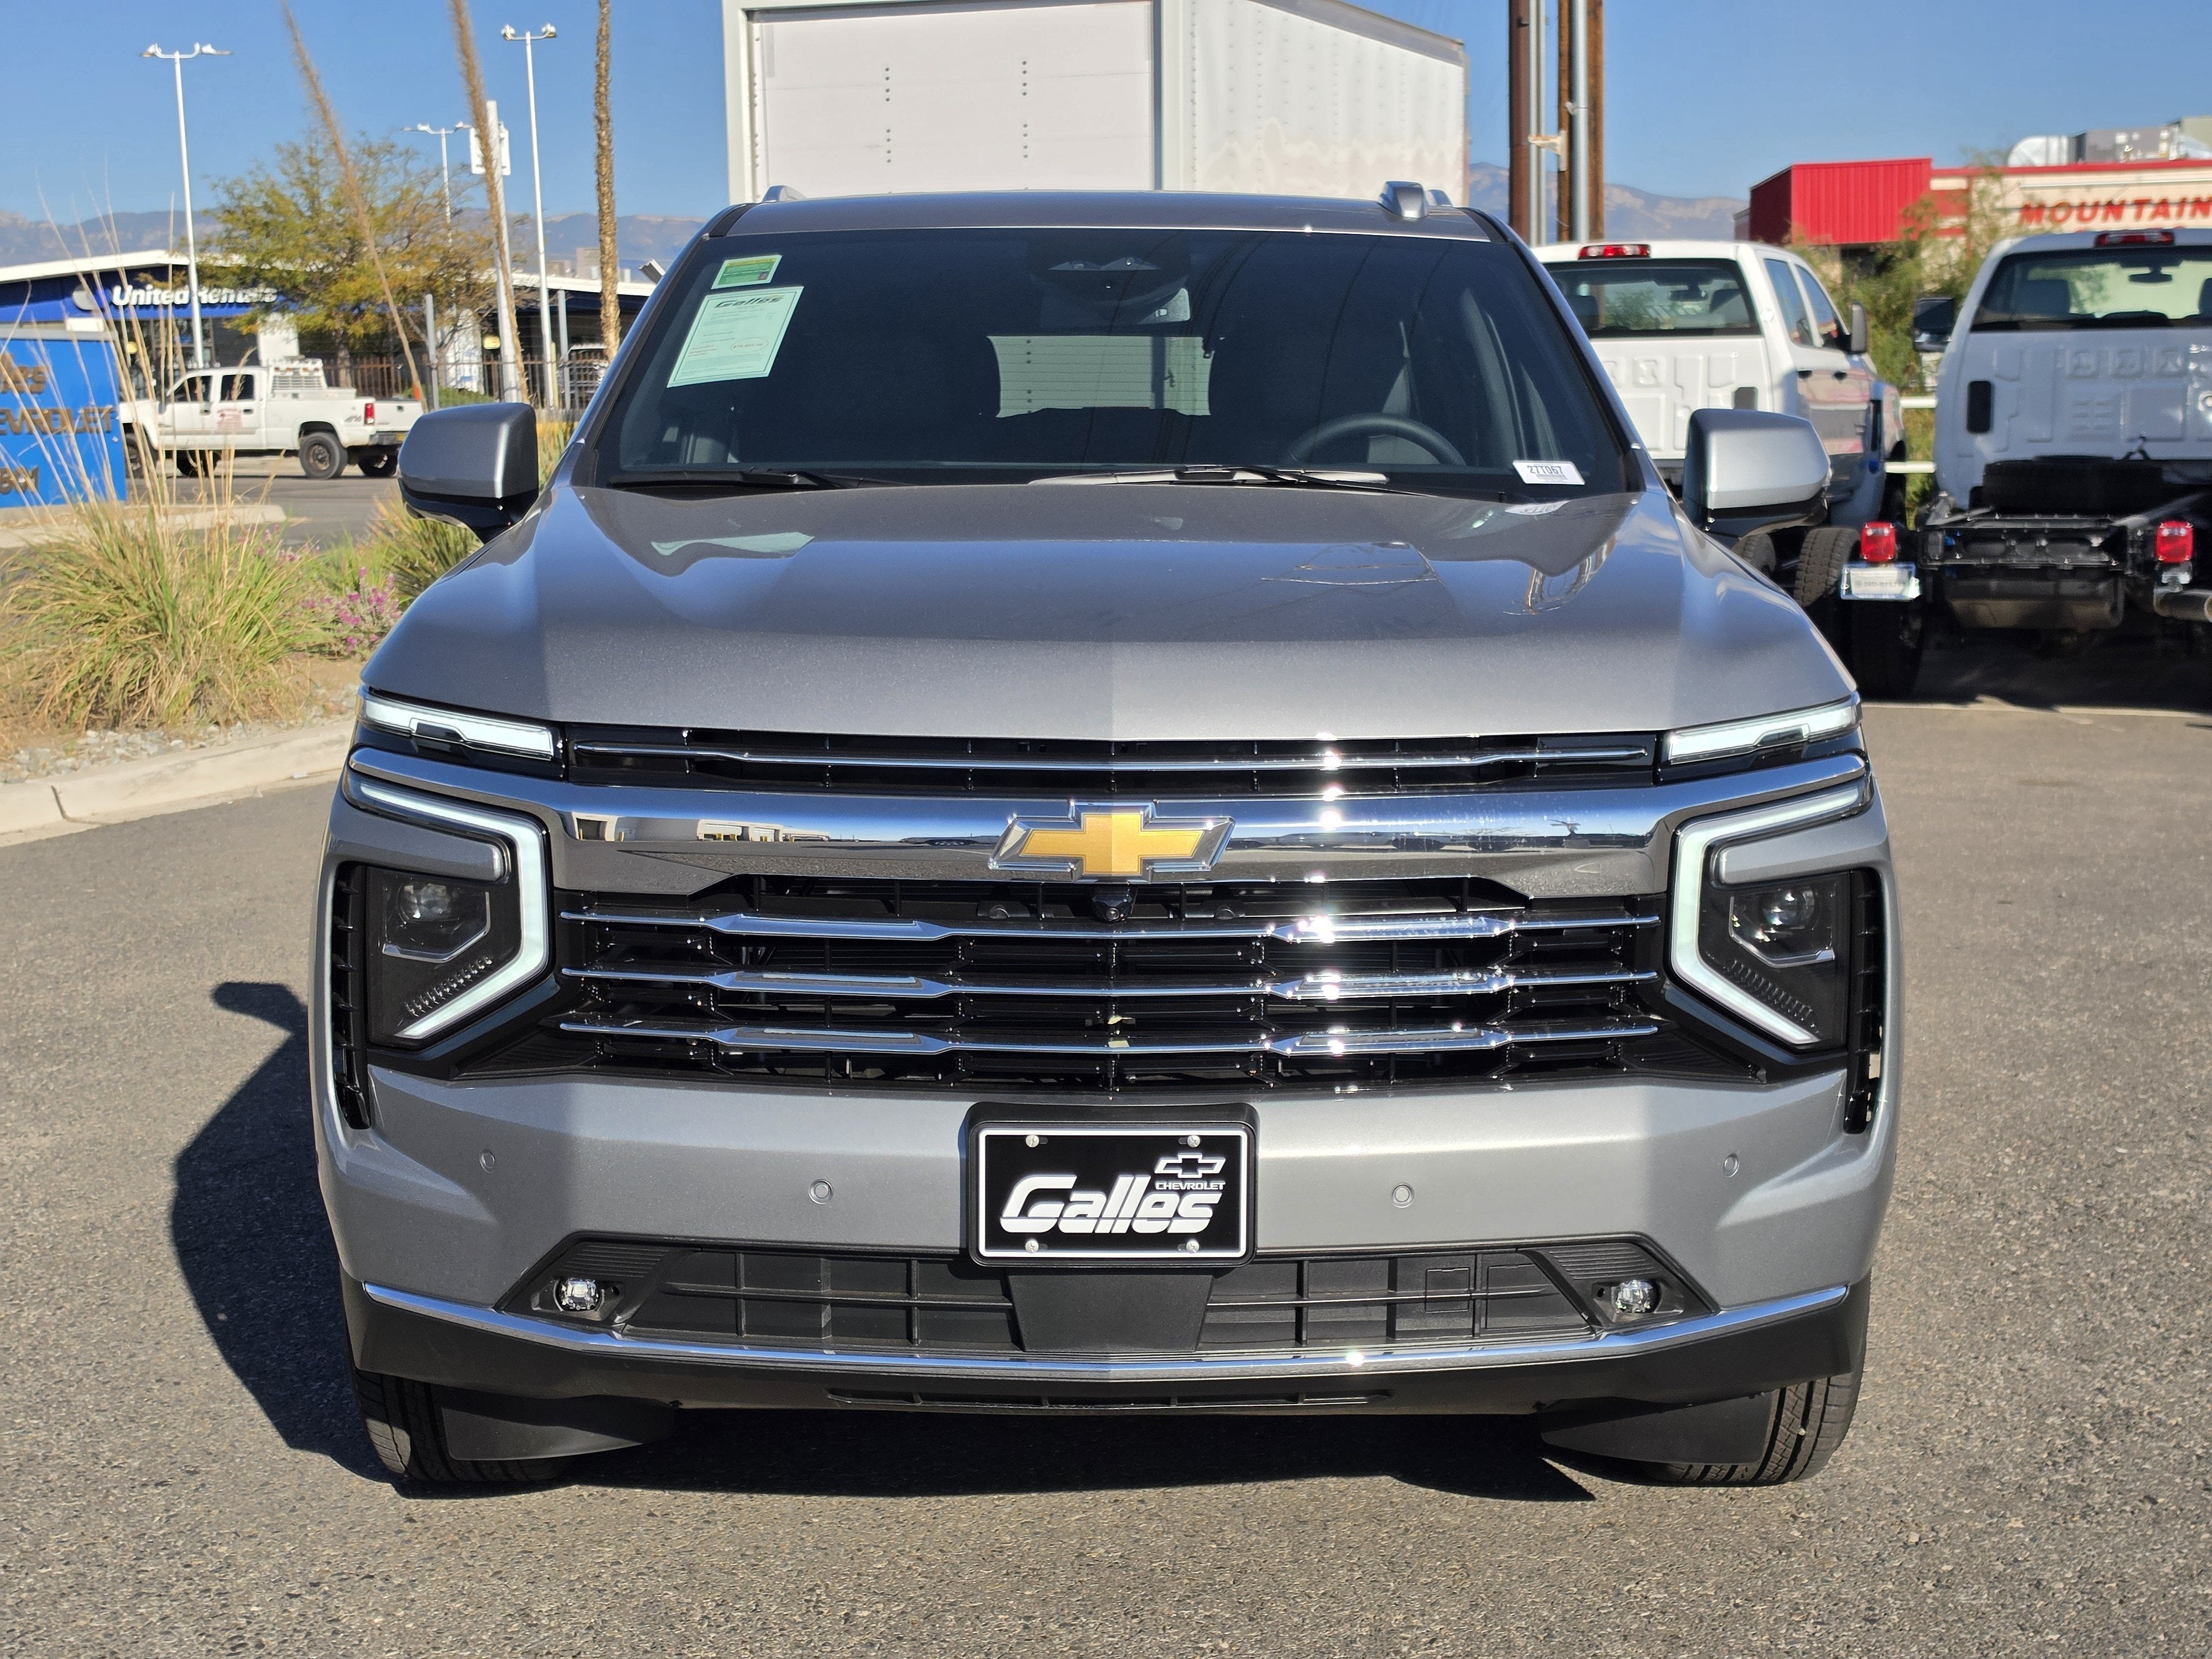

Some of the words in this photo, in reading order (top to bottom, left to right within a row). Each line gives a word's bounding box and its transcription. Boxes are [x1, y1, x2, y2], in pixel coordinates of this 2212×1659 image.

[2020, 196, 2212, 225] MOUNTAIN
[112, 284, 190, 305] United
[1527, 465, 1563, 474] 27T067
[1155, 1181, 1226, 1190] CHEVROLET
[1000, 1174, 1223, 1234] Galles
